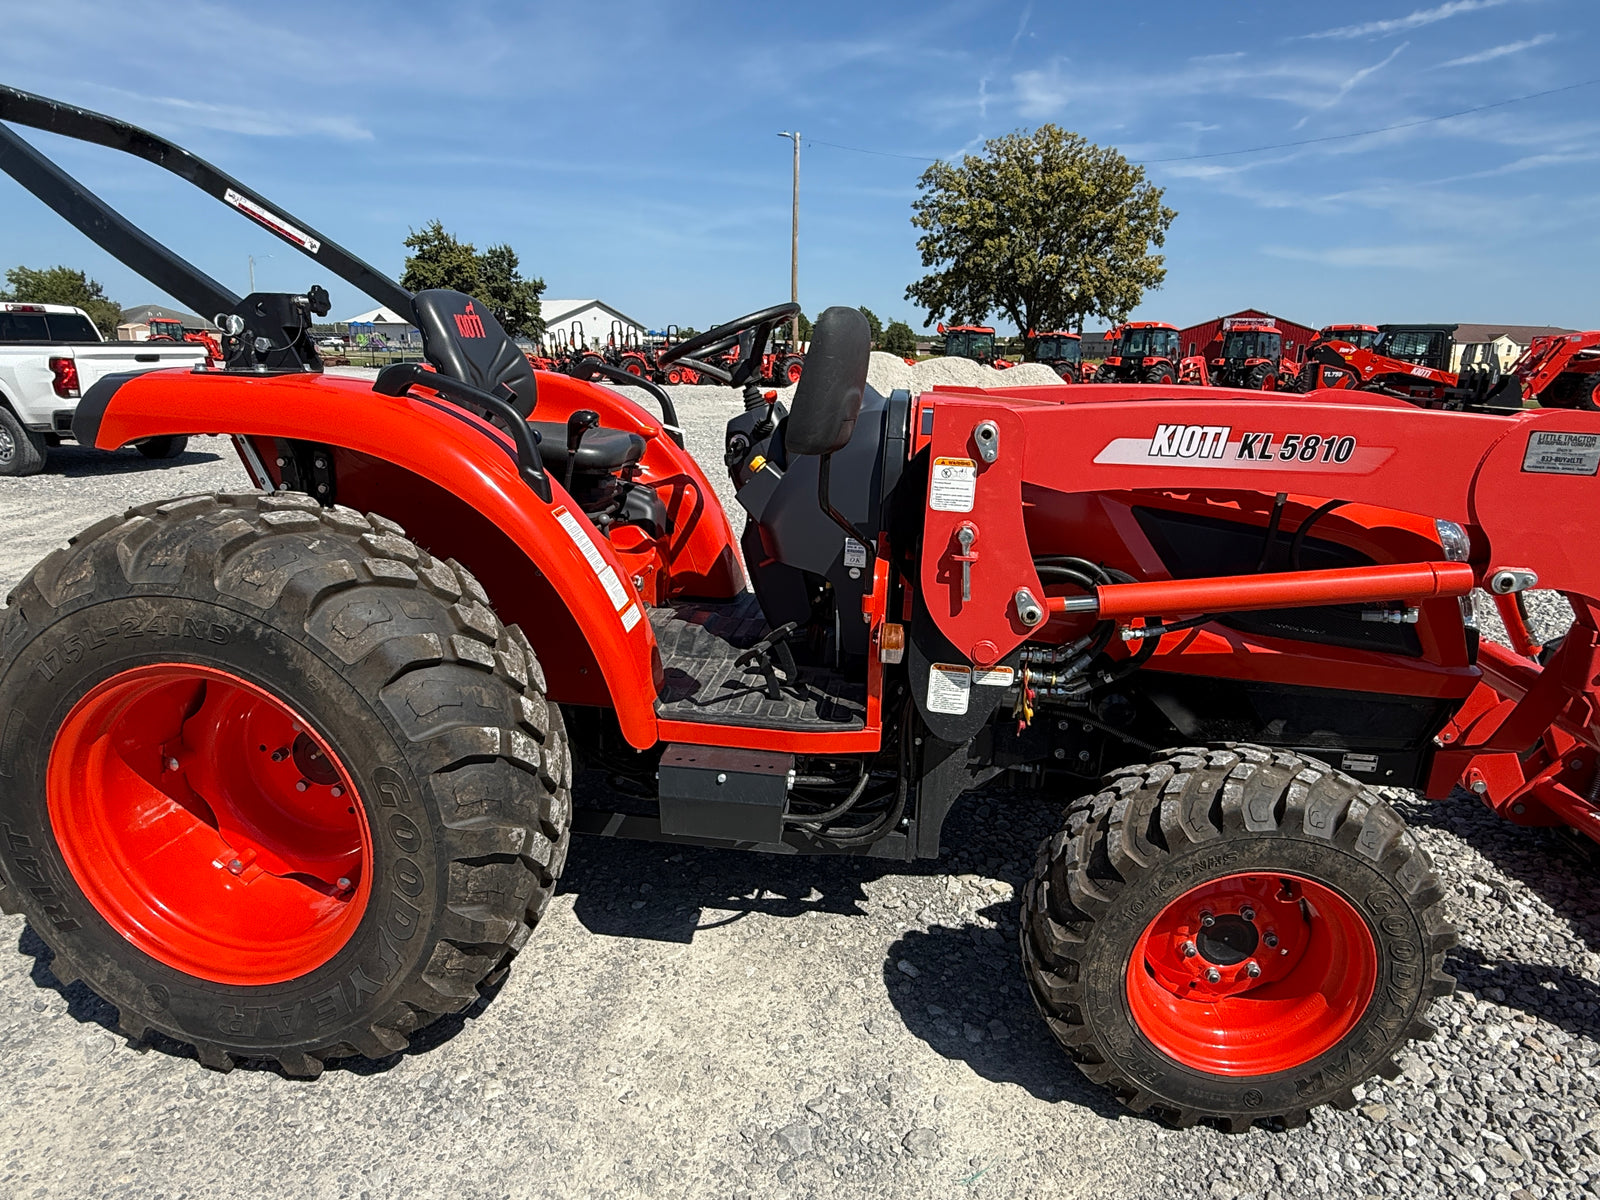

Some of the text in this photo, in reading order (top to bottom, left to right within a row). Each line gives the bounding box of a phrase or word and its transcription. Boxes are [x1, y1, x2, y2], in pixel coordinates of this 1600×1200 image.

[453, 313, 487, 339] KIOTI
[1410, 367, 1432, 378] KIOTI
[1148, 424, 1232, 458] KIOTI
[1538, 433, 1597, 443] LITTLE TRACTOR
[217, 765, 426, 1037] GOODYEAR
[1295, 891, 1418, 1098] GOODYEAR
